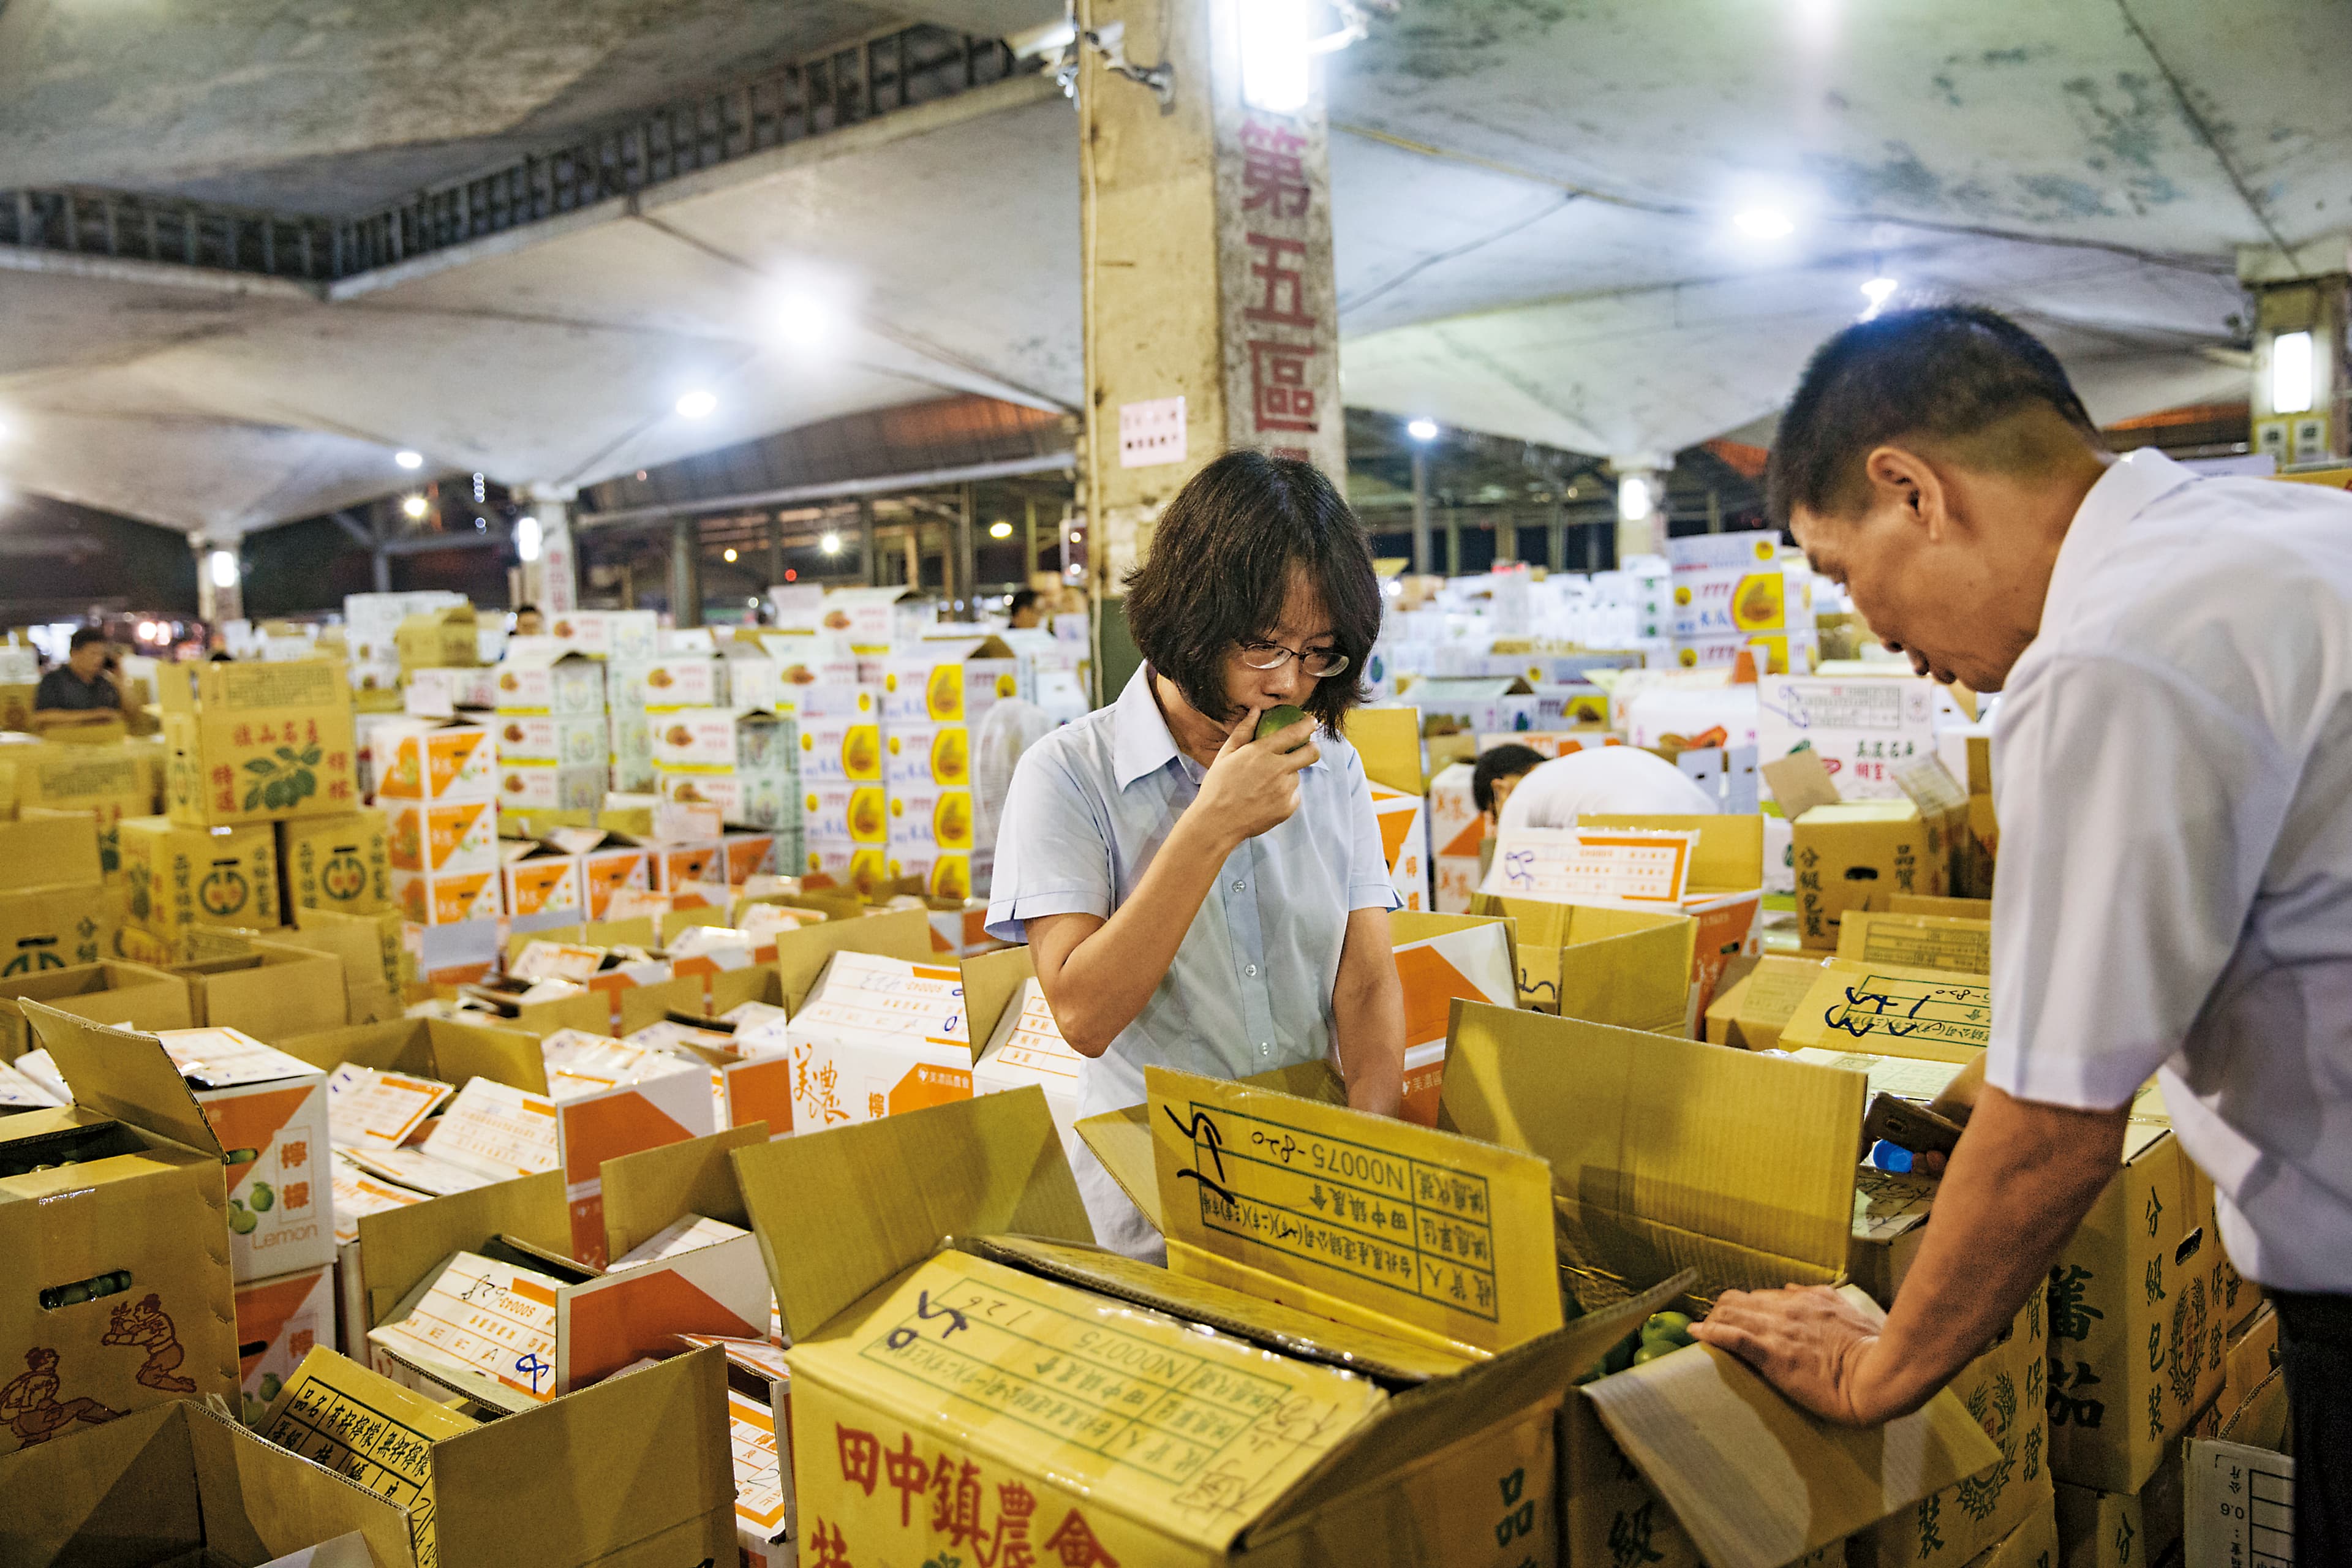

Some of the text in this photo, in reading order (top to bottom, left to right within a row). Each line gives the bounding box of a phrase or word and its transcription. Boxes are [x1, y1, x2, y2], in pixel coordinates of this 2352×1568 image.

[1238, 118, 1319, 462] 第五區
[1311, 1143, 1404, 1191] N00075
[251, 1224, 318, 1251] Lemon
[2145, 1186, 2166, 1443] 分級包裝
[1074, 1330, 1182, 1380] N00075
[293, 1389, 329, 1421] 品名
